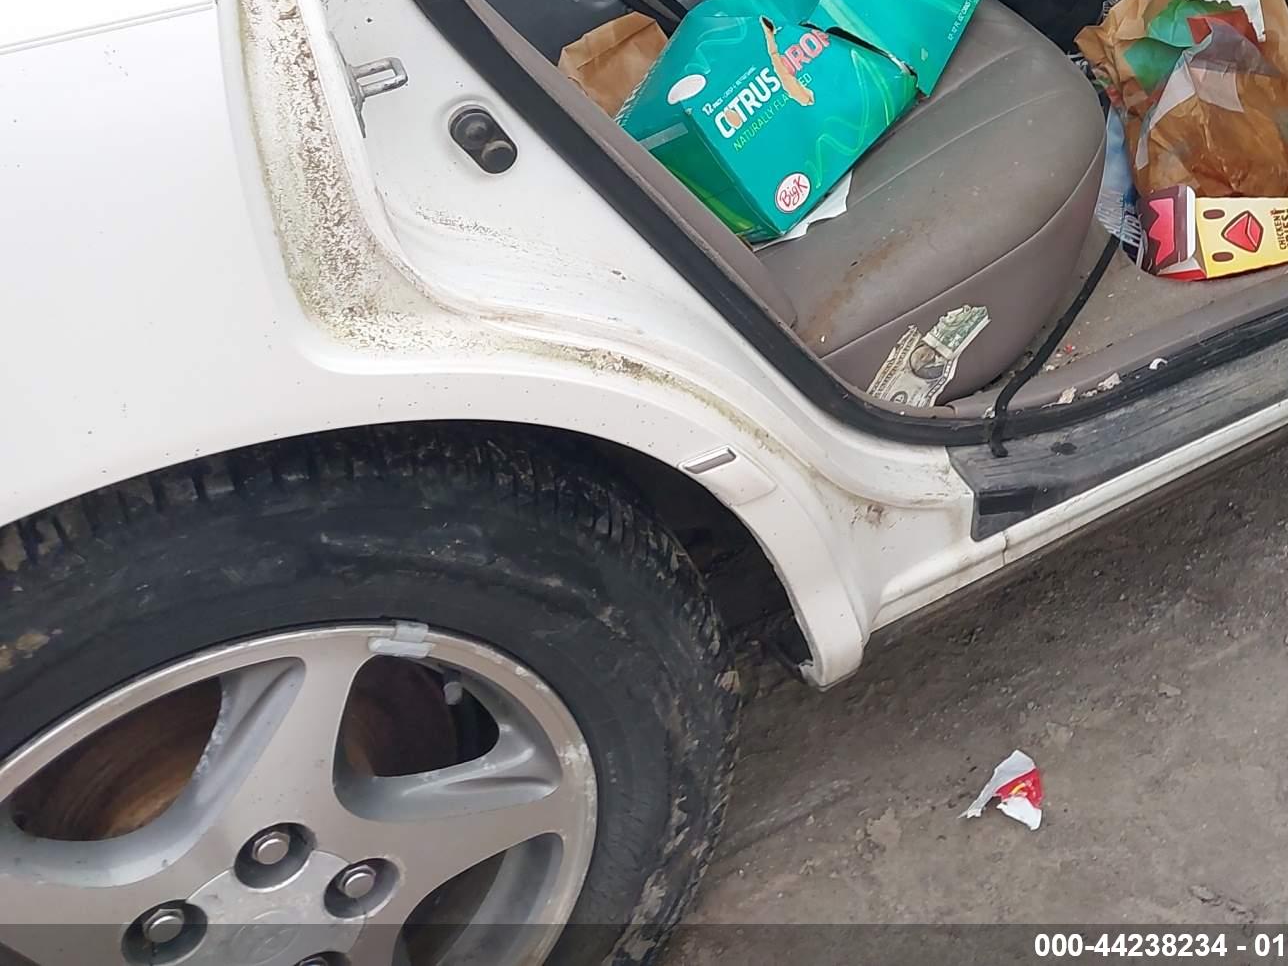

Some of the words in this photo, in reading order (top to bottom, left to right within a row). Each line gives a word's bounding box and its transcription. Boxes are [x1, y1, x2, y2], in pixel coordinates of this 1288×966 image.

[715, 67, 781, 138] CTRUS
[733, 105, 775, 151] NATURALLY
[774, 73, 812, 111] FLAED
[1273, 215, 1287, 250] CHICKEN
